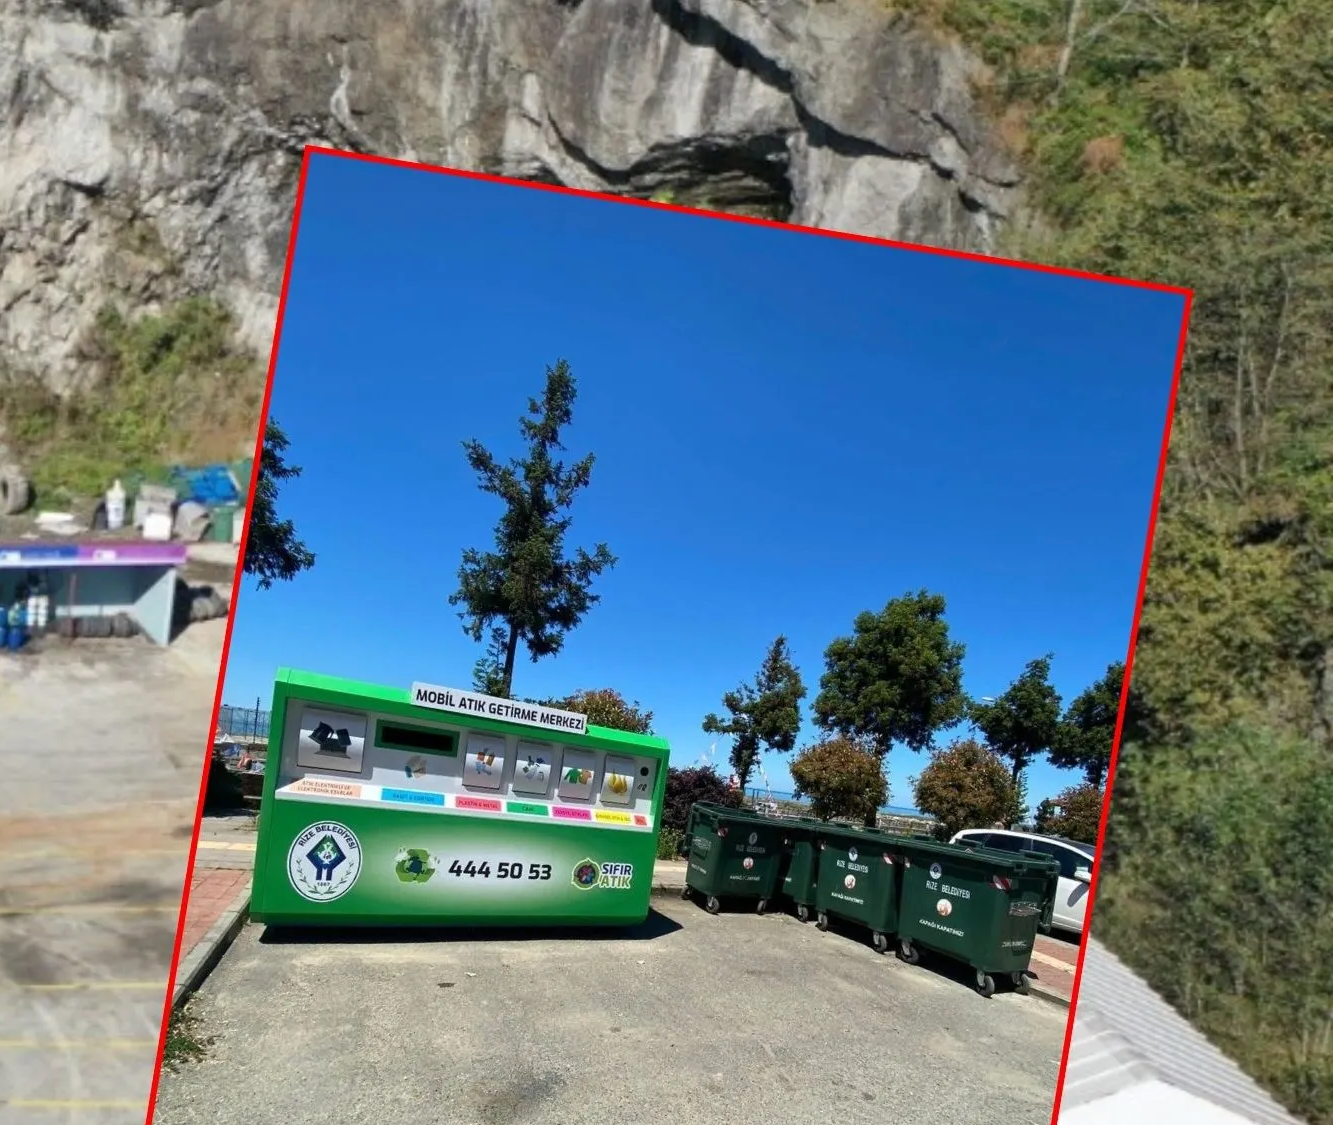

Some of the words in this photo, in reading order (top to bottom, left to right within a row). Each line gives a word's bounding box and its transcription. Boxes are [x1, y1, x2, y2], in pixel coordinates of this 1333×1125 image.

[416, 689, 455, 707] MOBİL
[459, 697, 486, 713] ATIK
[488, 703, 538, 722] GETİRME
[539, 714, 584, 731] MERKEZİ
[299, 831, 316, 847] RİZE
[316, 825, 358, 850] BELEDİYESİ
[448, 860, 490, 878] 444
[496, 862, 523, 879] 50
[528, 863, 552, 880] 53
[602, 863, 632, 876] SIFIR
[601, 875, 630, 888] ATIK
